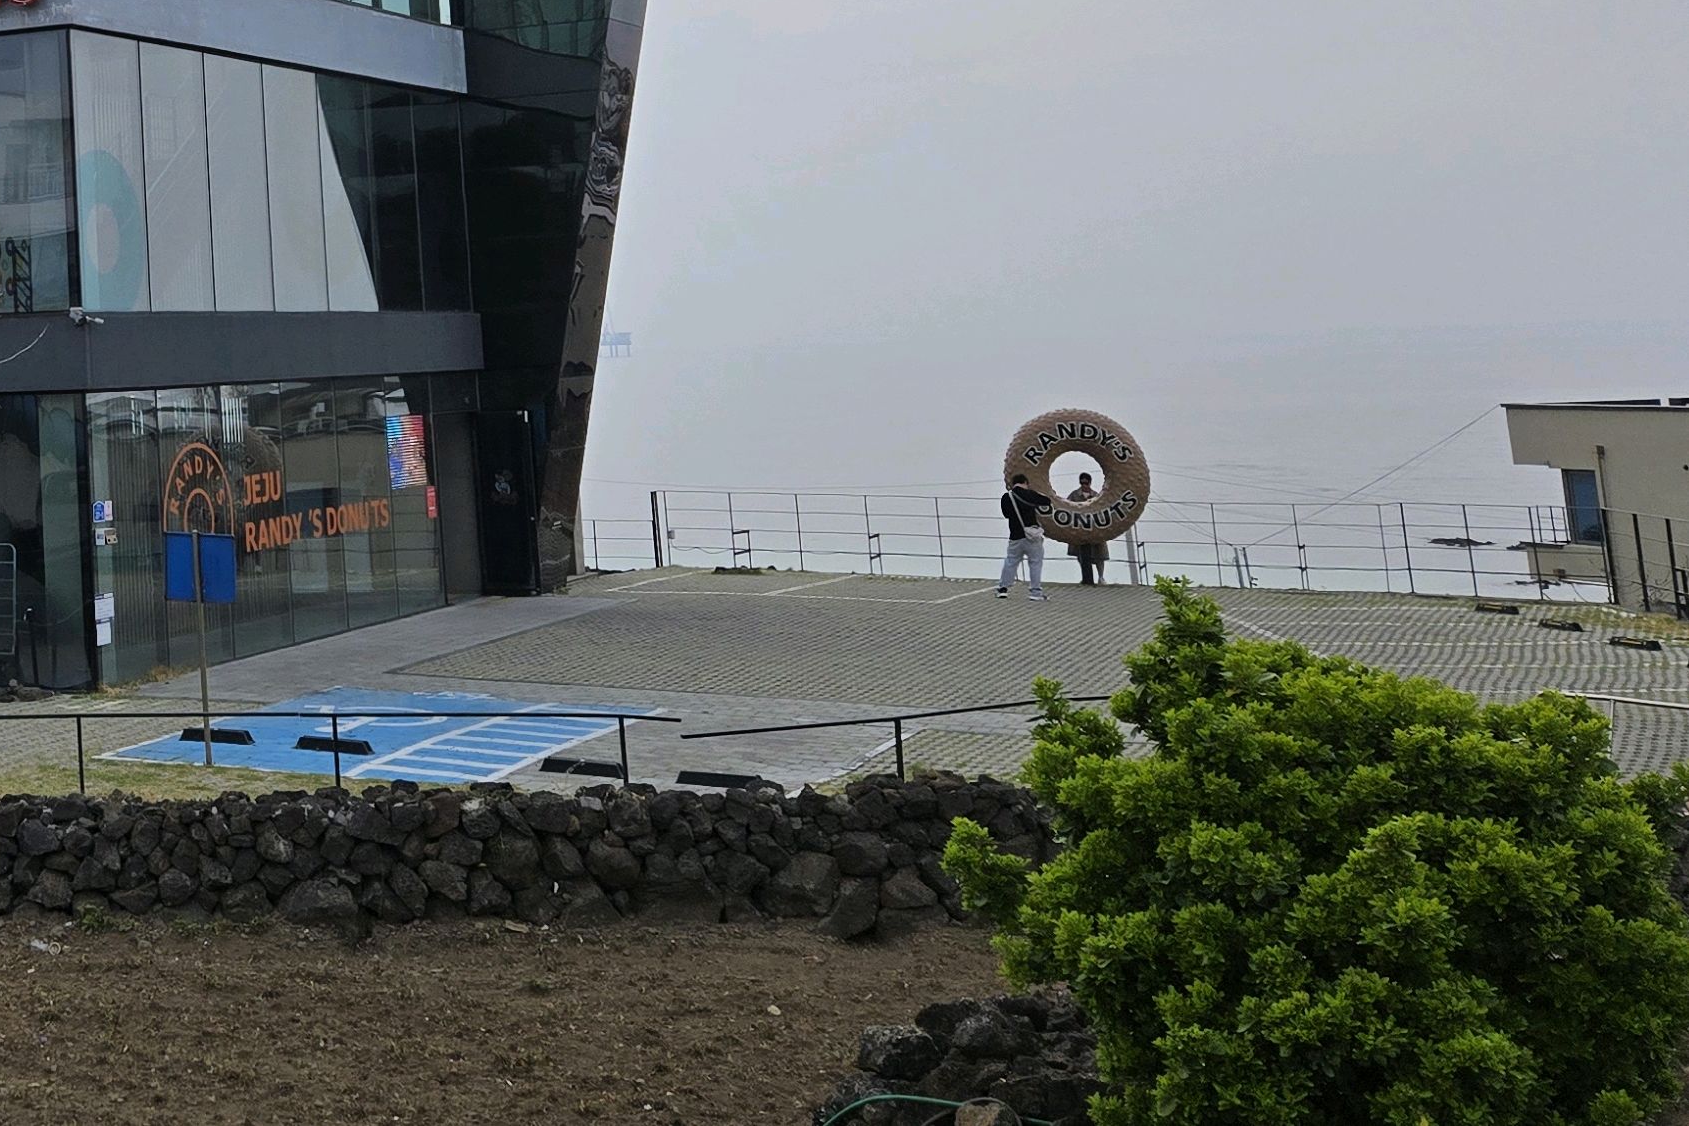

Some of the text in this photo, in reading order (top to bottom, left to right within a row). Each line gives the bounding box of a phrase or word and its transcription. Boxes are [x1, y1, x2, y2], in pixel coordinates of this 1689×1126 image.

[1023, 422, 1132, 466] RANDY'S
[243, 470, 281, 506] JEJU
[326, 498, 390, 535] DONUTS
